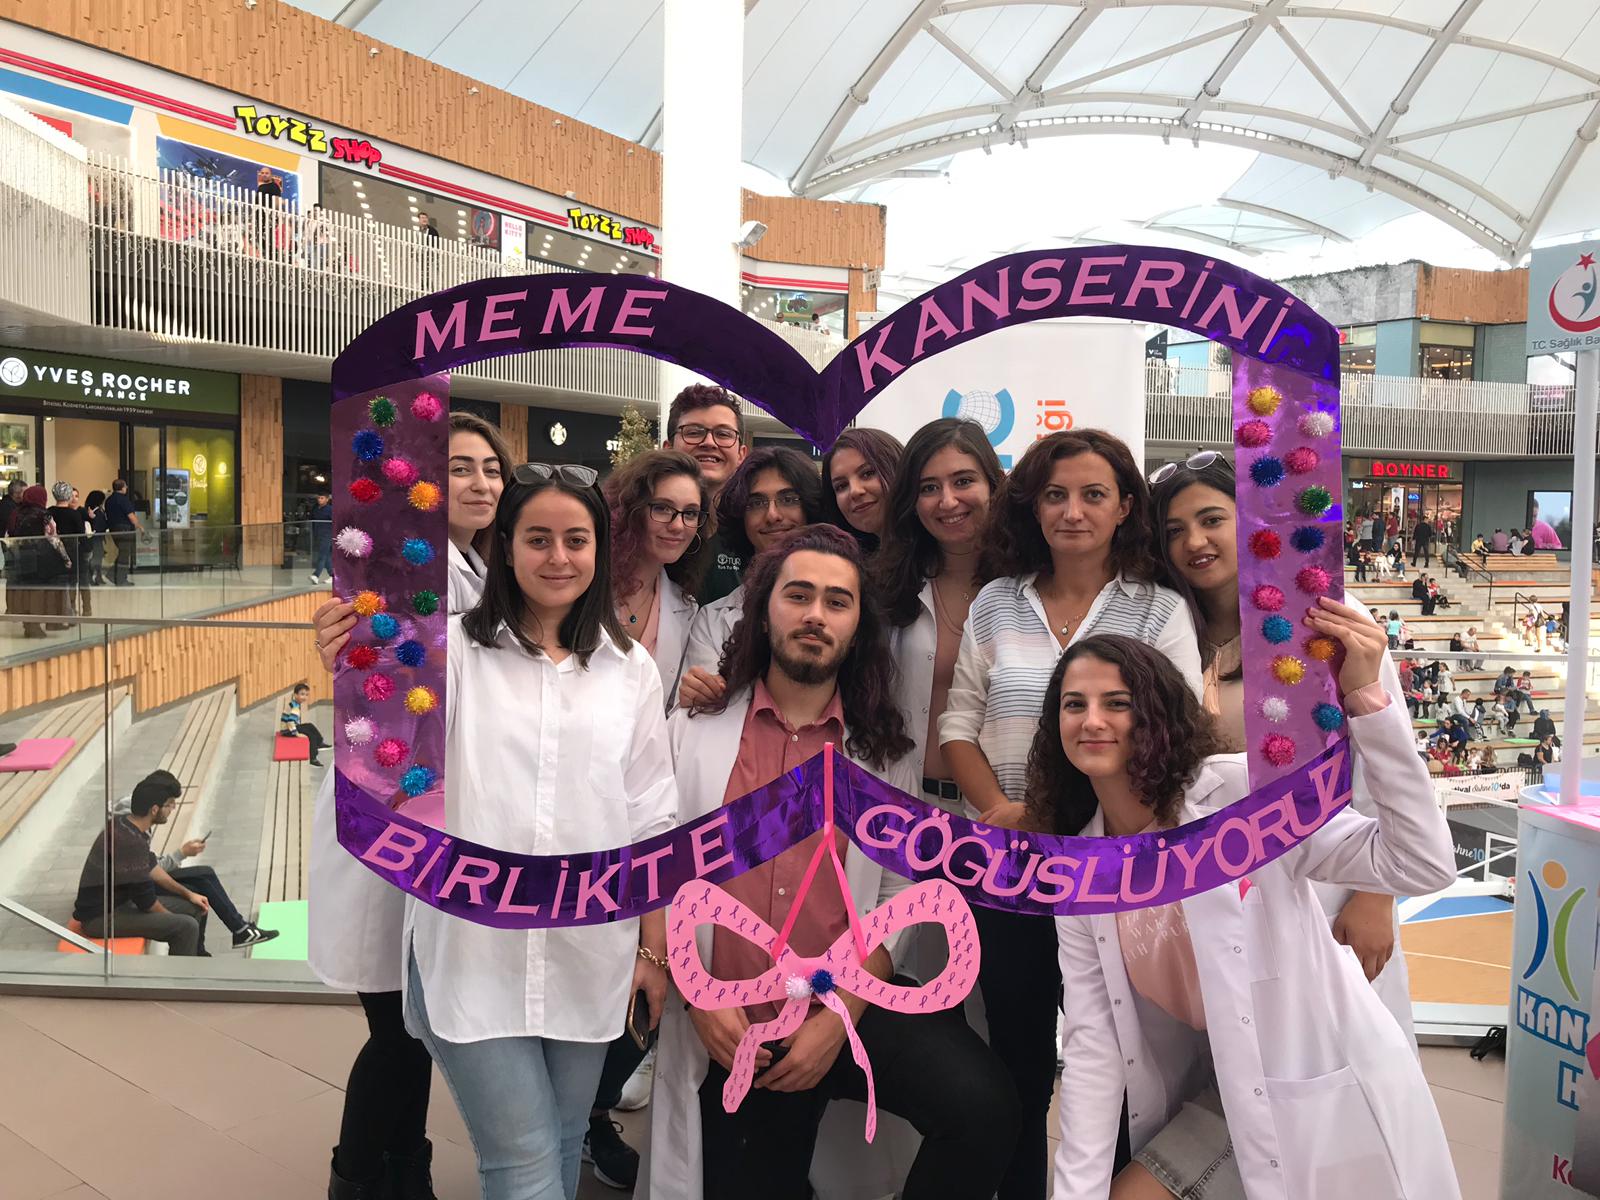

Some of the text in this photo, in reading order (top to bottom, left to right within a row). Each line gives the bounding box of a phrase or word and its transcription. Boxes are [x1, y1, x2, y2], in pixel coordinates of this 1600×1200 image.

[330, 138, 382, 169] SHOP
[623, 227, 655, 249] SHOP
[413, 286, 669, 360] MEME
[853, 254, 1295, 393] KANSERİNİ
[1549, 336, 1582, 350] Sağlık
[33, 365, 191, 395] YVES ROCHER
[84, 387, 147, 401] FRANCE
[1372, 462, 1449, 478] BOYNER
[854, 751, 1352, 904] GÖĞÜSLÜYORUZ
[361, 815, 734, 919] BİRLİKTE
